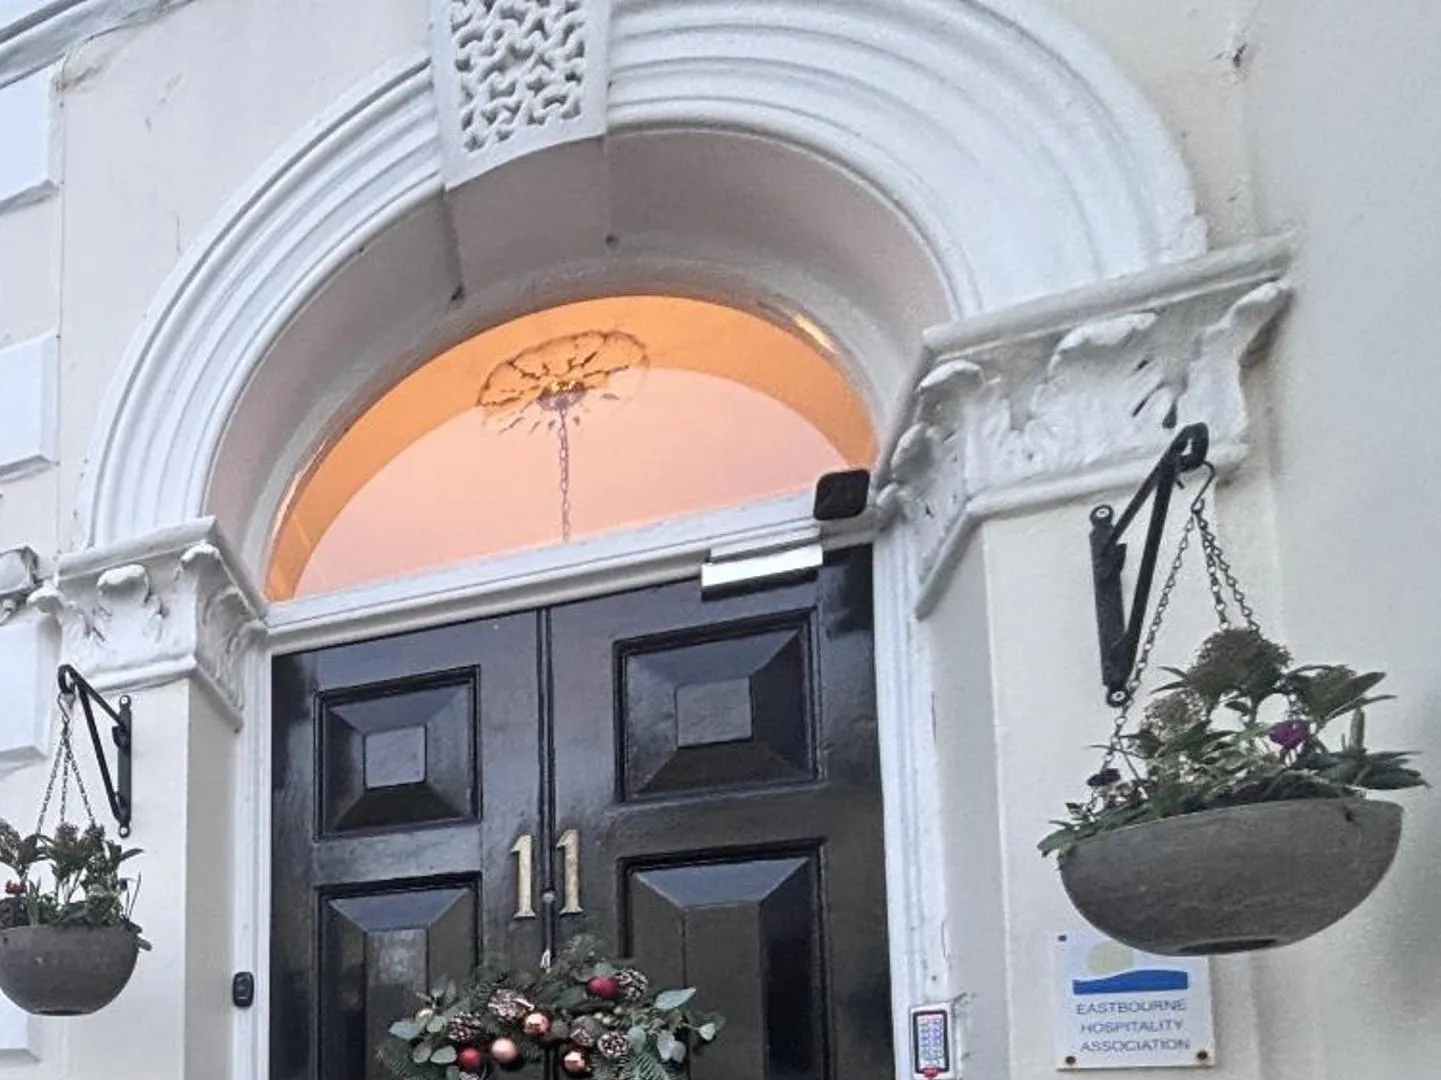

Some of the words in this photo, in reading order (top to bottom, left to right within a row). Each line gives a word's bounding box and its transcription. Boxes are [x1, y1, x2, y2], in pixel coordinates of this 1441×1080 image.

[511, 829, 583, 918] 11
[1076, 999, 1187, 1015] EASTBOURNE
[1081, 1019, 1184, 1034] HOSPITALITY
[1080, 1038, 1190, 1052] ASSOCIATION
